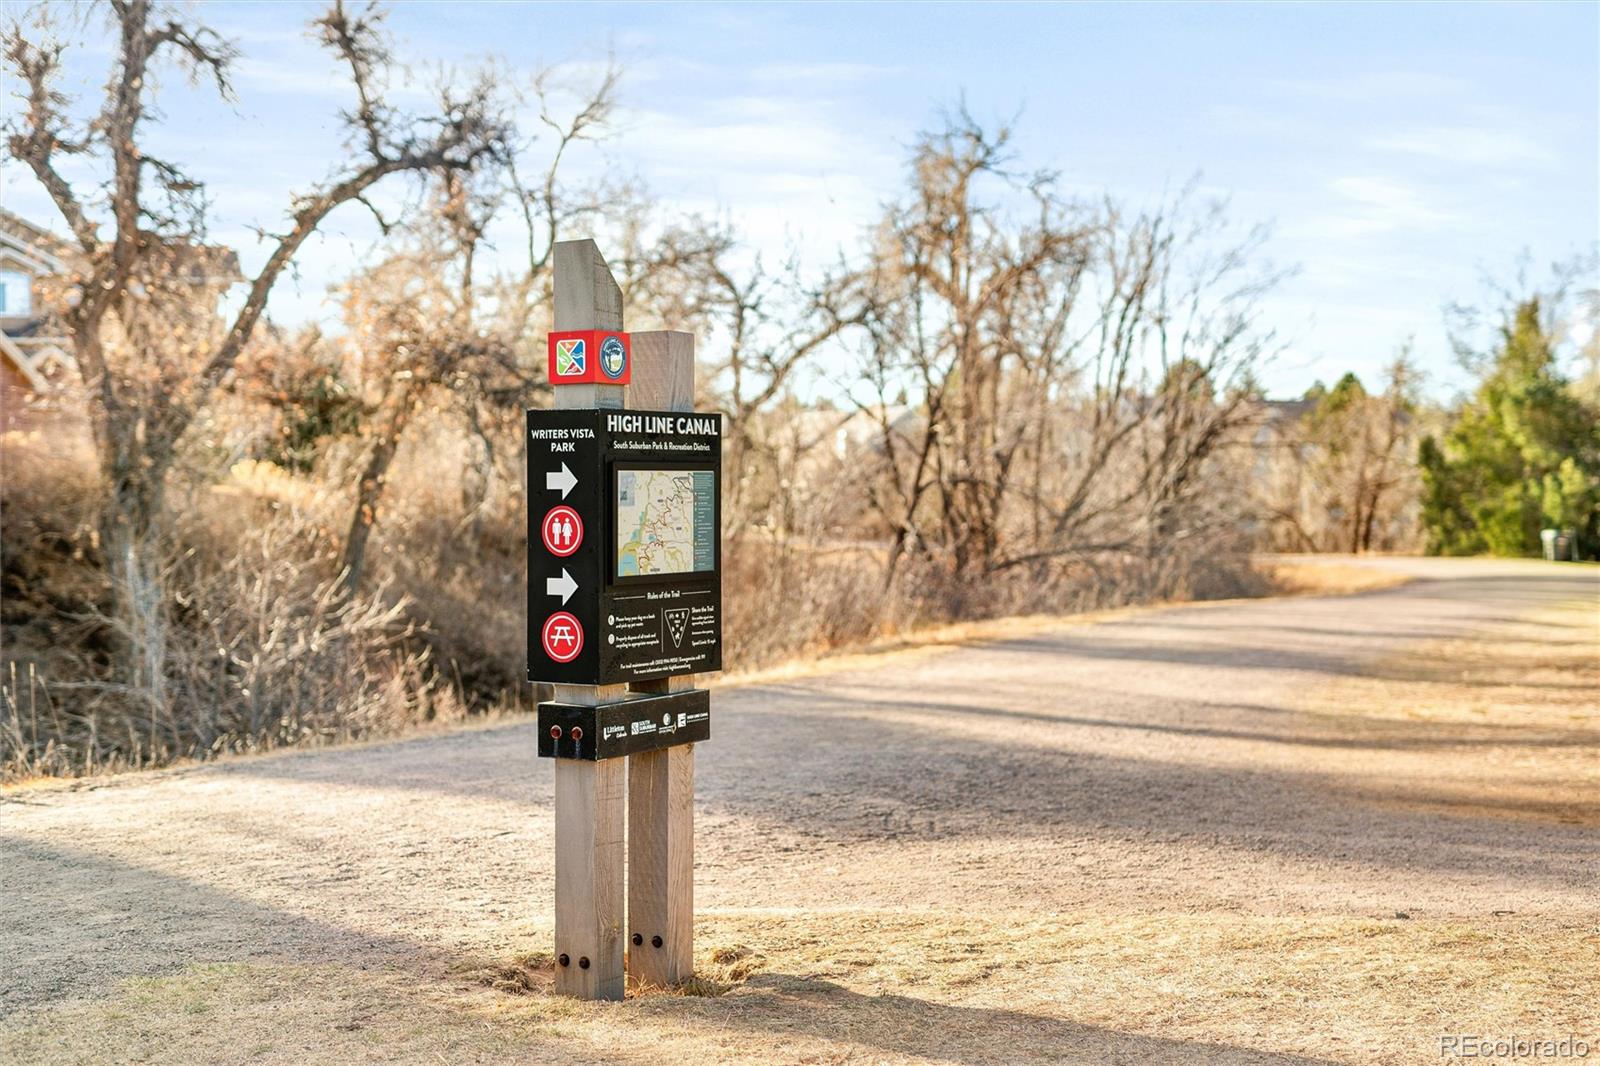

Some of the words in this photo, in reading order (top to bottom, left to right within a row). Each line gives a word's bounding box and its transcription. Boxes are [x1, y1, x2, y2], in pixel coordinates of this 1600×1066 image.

[606, 414, 642, 433] HIGH
[645, 416, 674, 434] LINE
[676, 417, 718, 436] CANAL
[531, 429, 569, 440] WRITERS
[570, 428, 595, 439] VISTA
[551, 442, 575, 452] PARK
[613, 440, 629, 450] South
[629, 440, 651, 450] Suburban
[652, 441, 663, 450] Park
[664, 442, 668, 450] &
[668, 442, 692, 450] Recreation
[693, 442, 710, 451] District
